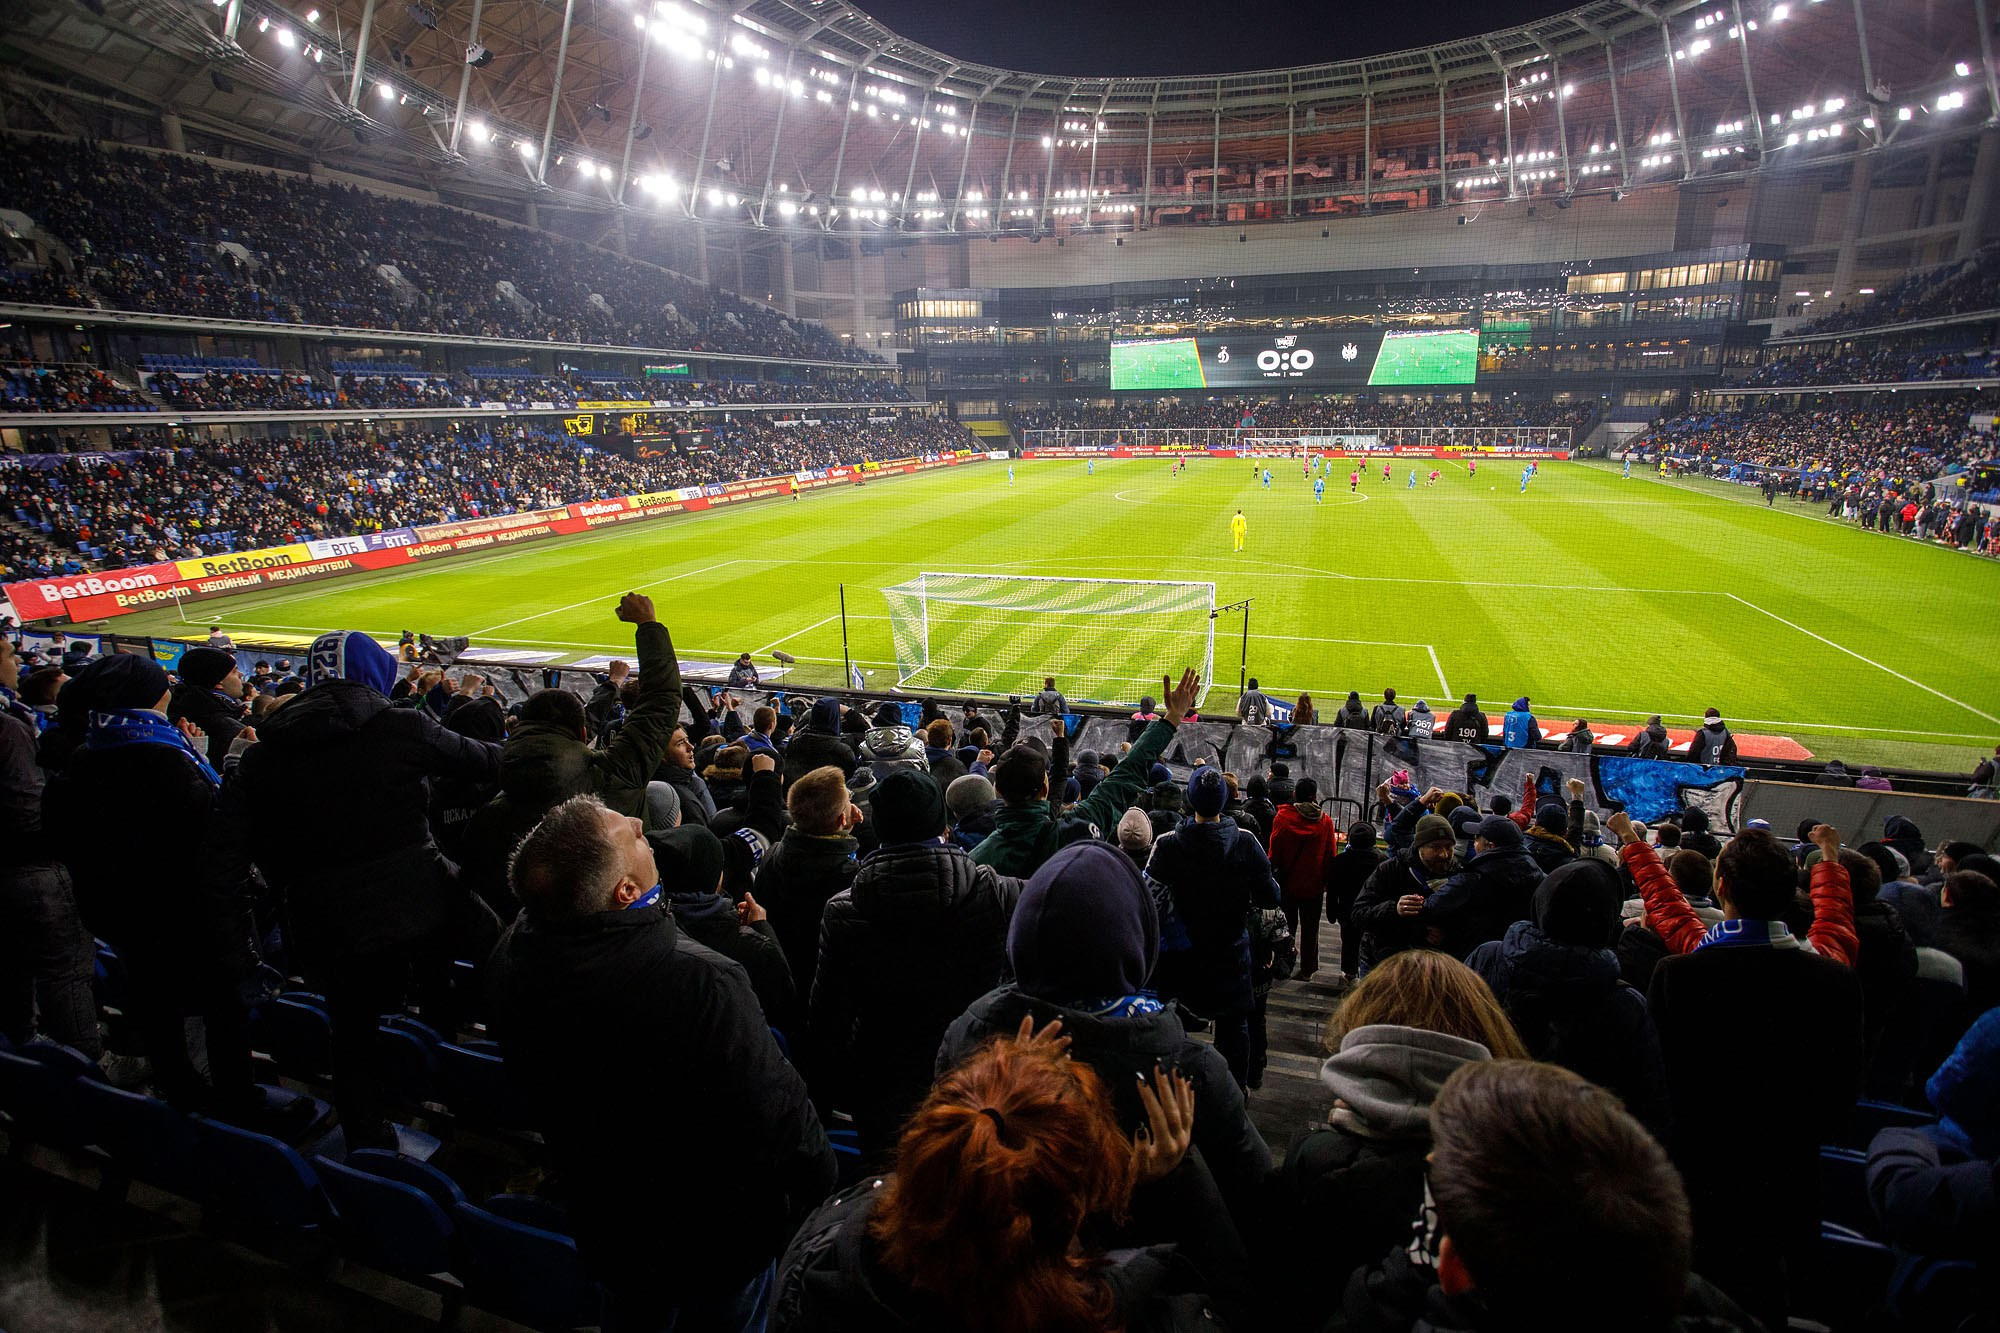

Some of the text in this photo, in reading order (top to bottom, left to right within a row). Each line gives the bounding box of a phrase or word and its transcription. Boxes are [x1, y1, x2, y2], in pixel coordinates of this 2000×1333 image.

[1257, 349, 1314, 370] 0:0
[638, 495, 673, 507] BetBoom
[580, 502, 623, 517] BetBoom
[331, 541, 360, 556] ВТБ
[384, 533, 412, 549] ВТБ
[406, 525, 551, 558] BetBoom УБОЙНЫЙ МЕДИАФУТБОЛ
[202, 553, 293, 577] BetBoom
[38, 573, 159, 602] BetBoom
[115, 559, 353, 608] BetBoom УБОЙНЫЙ МЕДИАФУТБОЛ
[1458, 728, 1477, 738] 190
[1508, 732, 1516, 742] 3
